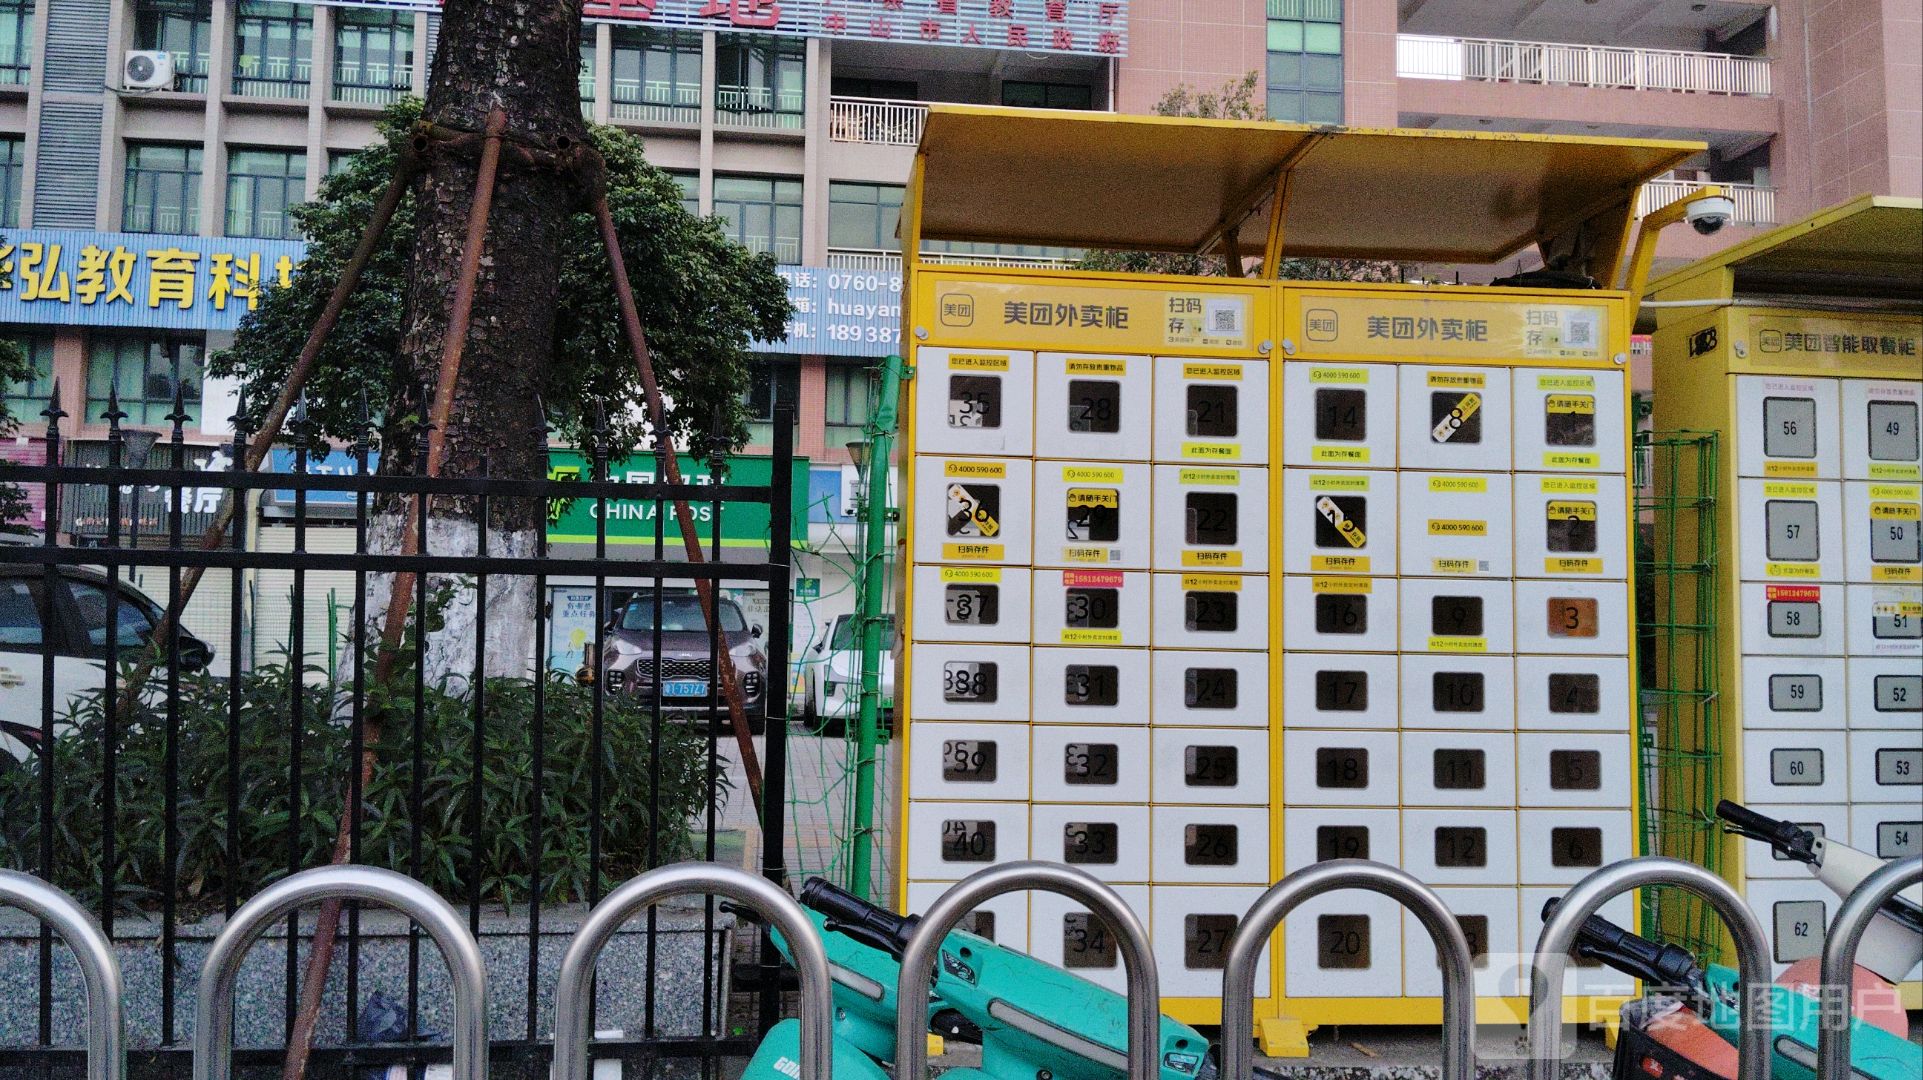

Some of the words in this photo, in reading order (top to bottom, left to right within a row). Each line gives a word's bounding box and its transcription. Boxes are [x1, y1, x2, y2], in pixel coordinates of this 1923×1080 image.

[825, 13, 1120, 54] 中山市人民政府
[828, 274, 901, 293] 0760-8
[943, 303, 971, 317] 美团
[1003, 301, 1129, 330] 美团外卖柜
[1169, 297, 1202, 314] 扫码
[1168, 317, 1185, 334] 存
[1308, 318, 1335, 332] 美团
[1526, 309, 1558, 326] 扫码
[1367, 316, 1488, 343] 美团外卖柜
[1784, 332, 1916, 356] 美团智能取餐柜
[960, 391, 991, 415] 35
[1080, 397, 1112, 421] 28
[1199, 401, 1226, 423] 21
[1328, 405, 1357, 428] 14
[1449, 407, 1463, 430] 8
[1783, 421, 1797, 436] 56
[1886, 421, 1900, 436] 49
[976, 466, 989, 474] 590
[590, 504, 657, 520] CHINA
[959, 498, 990, 523] 36
[1077, 505, 1107, 527] 29
[1199, 508, 1227, 532] 22
[1327, 510, 1356, 533] 15
[1471, 524, 1484, 532] 600
[1567, 515, 1581, 536] 2
[1787, 525, 1801, 539] 57
[1890, 527, 1903, 541] 50
[958, 545, 989, 554] 扫码存件
[1069, 549, 1101, 558] 扫码存件
[1438, 559, 1470, 568] 扫码存件
[1075, 596, 1106, 620] 30
[1197, 601, 1226, 623] 23
[1328, 603, 1357, 626] 16
[1452, 606, 1466, 628] 9
[1566, 606, 1579, 630] 3
[1786, 611, 1800, 626] 58
[1894, 614, 1907, 628] 51
[1077, 673, 1105, 697] 31
[1328, 681, 1358, 704] 17
[1448, 683, 1475, 706] 10
[1790, 685, 1804, 699] 59
[1893, 688, 1907, 702] 52
[1077, 753, 1108, 777] 32
[1196, 757, 1228, 780] 25
[1328, 758, 1358, 782] 18
[1448, 759, 1473, 782] 11
[1568, 758, 1583, 782] 5
[1790, 761, 1804, 775] 60
[1896, 761, 1910, 775] 53
[953, 832, 986, 855] 40
[1075, 831, 1107, 855] 33
[1197, 834, 1229, 857] 26
[1329, 836, 1359, 859] 19
[1449, 836, 1475, 859] 12
[1569, 837, 1583, 859] 6
[1895, 831, 1908, 845] 54
[1794, 922, 1808, 936] 62
[1074, 929, 1105, 954] 34
[1197, 930, 1229, 954] 27
[1330, 931, 1360, 955] 20
